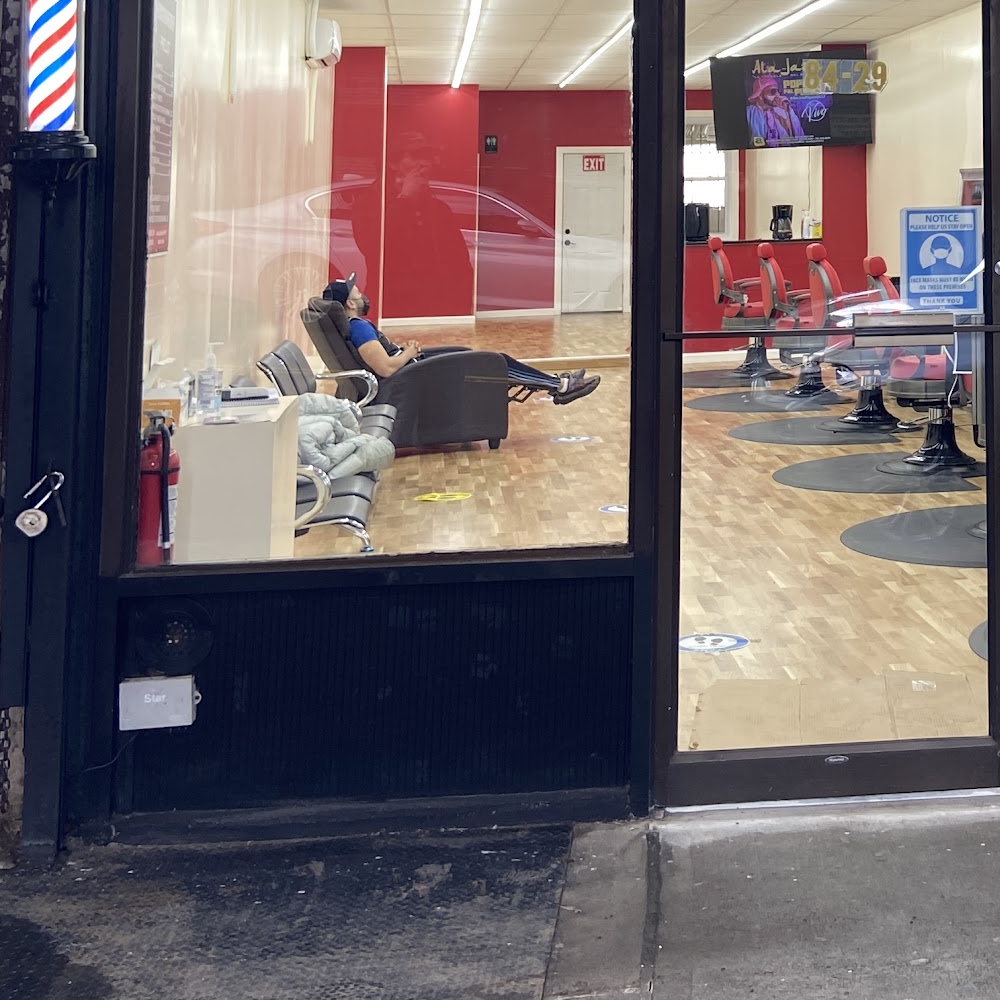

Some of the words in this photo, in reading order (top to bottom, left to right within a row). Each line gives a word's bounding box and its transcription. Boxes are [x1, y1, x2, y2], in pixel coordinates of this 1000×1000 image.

[803, 58, 889, 93] 84-29
[584, 158, 605, 170] EXIT
[925, 214, 959, 222] NOTICE
